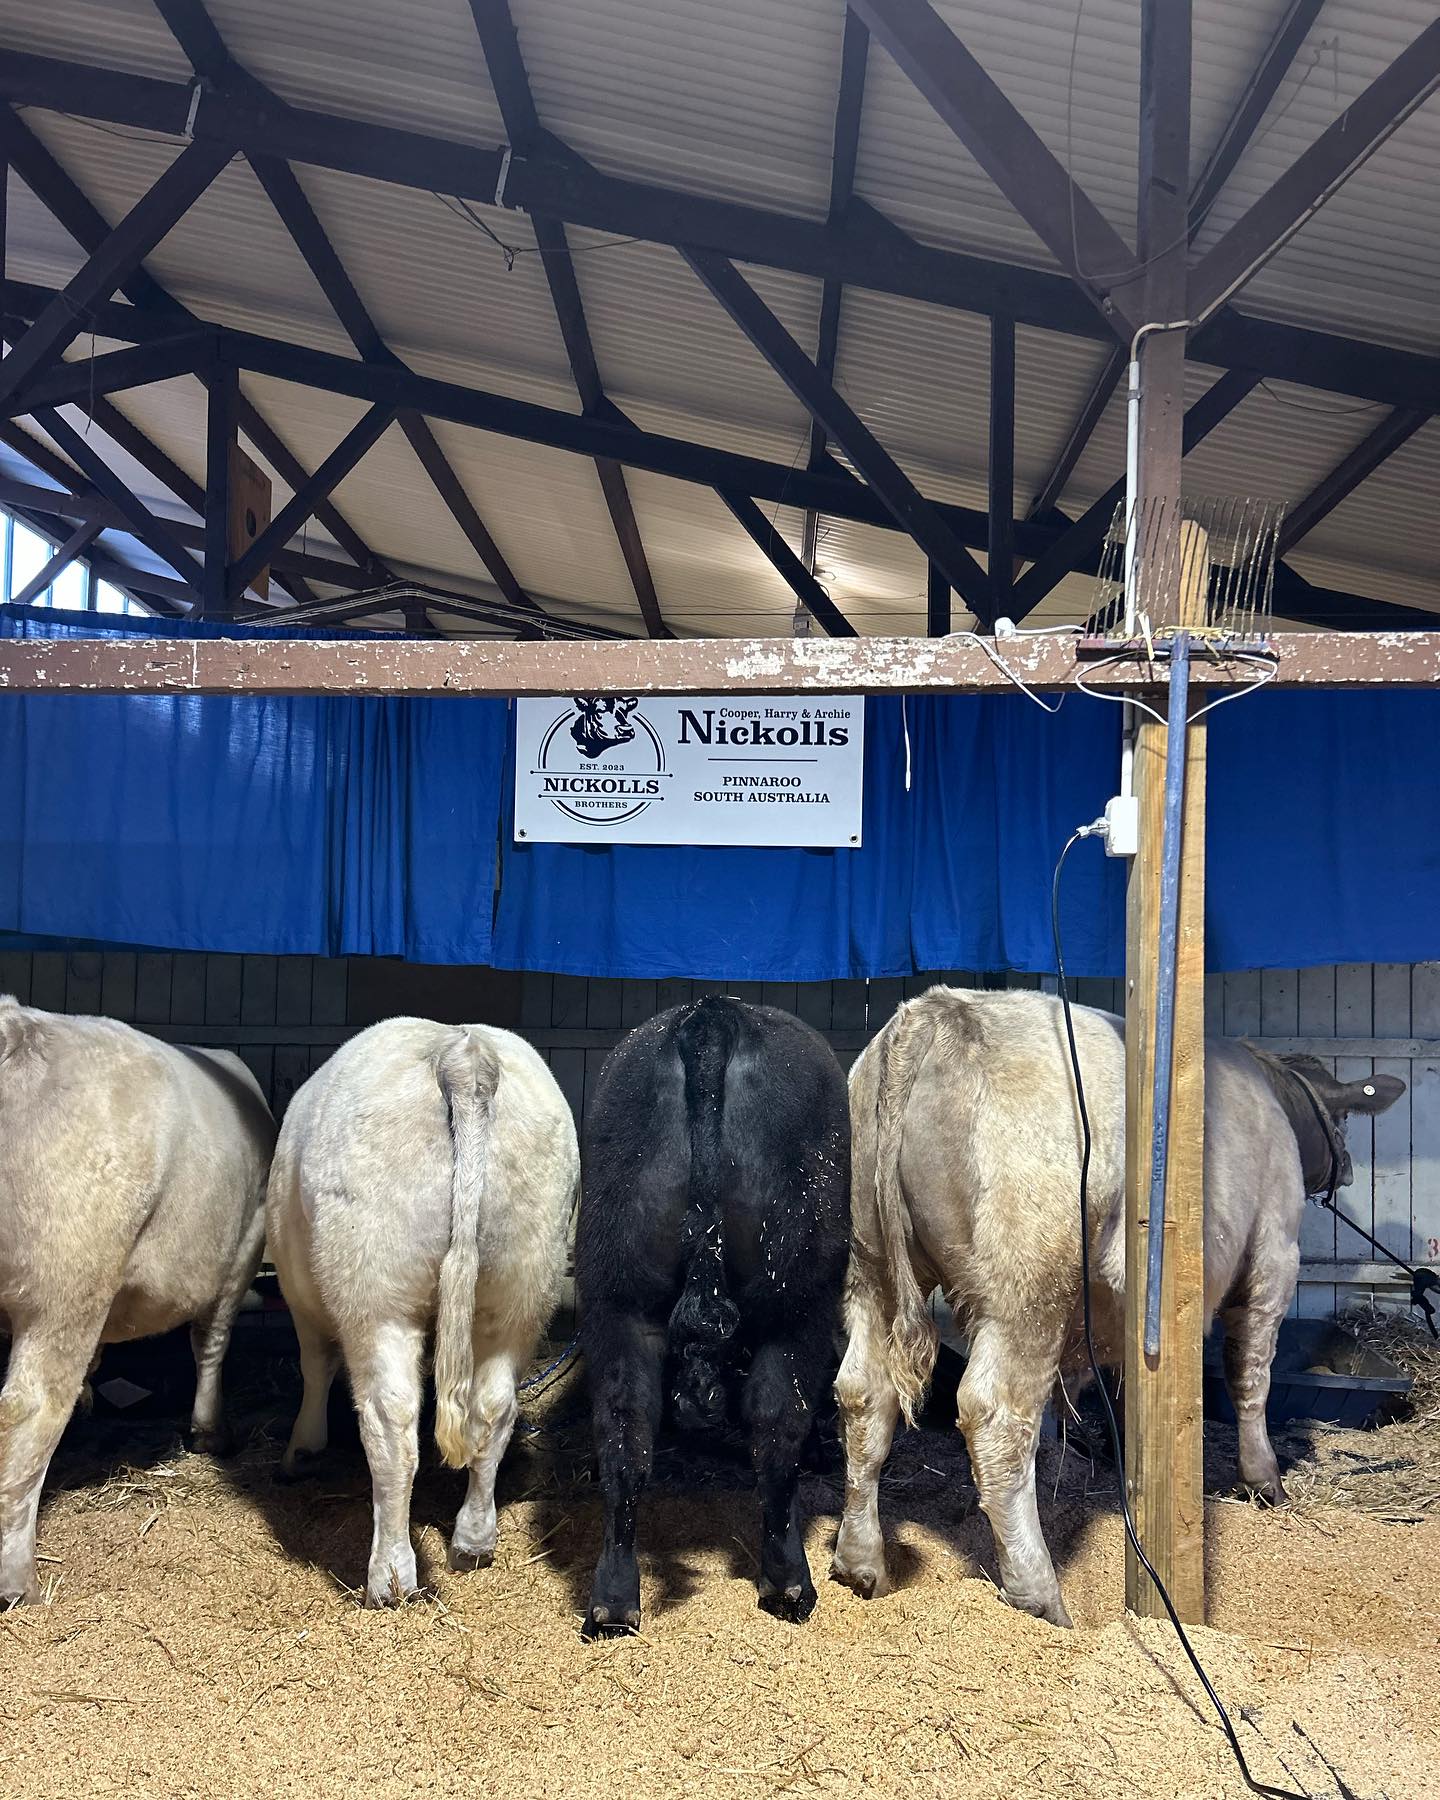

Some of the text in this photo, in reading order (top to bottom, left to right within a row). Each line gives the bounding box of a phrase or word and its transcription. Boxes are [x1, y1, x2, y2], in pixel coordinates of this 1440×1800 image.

[719, 707, 851, 720] Cooper, Harry & Archie
[677, 709, 849, 746] Nickolls
[579, 763, 599, 771] EST.
[543, 777, 660, 794] NICKOLLS
[723, 776, 802, 787] PINNAROO
[693, 791, 830, 803] SOUTH AUSTRALIA
[574, 800, 628, 809] BROTHERS
